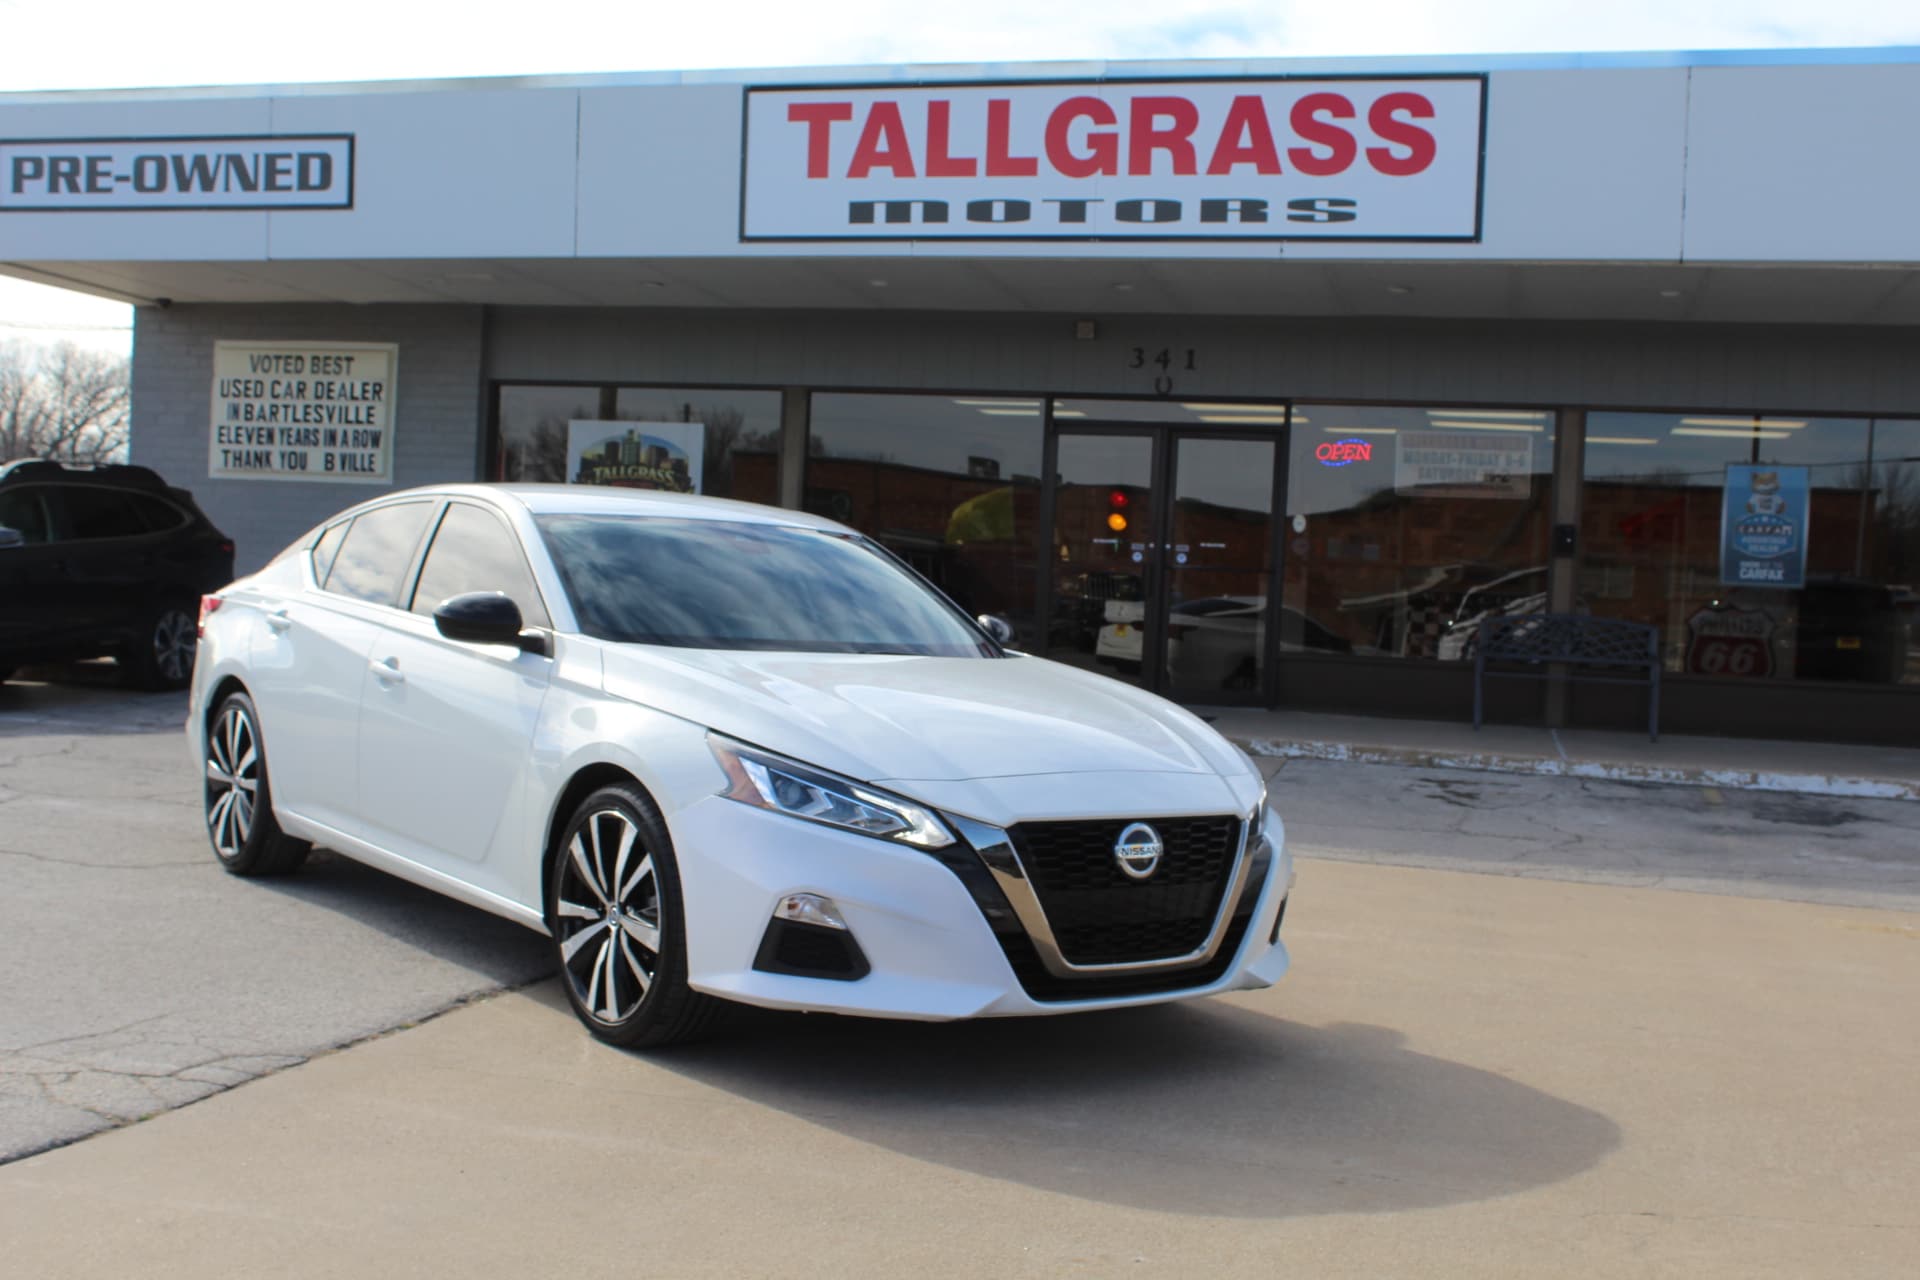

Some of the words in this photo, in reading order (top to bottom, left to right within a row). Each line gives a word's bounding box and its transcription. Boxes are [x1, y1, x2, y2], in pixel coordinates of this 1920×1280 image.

[788, 91, 1437, 179] TALLGRASS
[11, 152, 332, 193] PRE-OWNED
[847, 197, 1358, 224] MOTORS
[250, 354, 304, 374] VOTED
[310, 355, 355, 375] BEST
[1127, 347, 1198, 371] 341
[220, 379, 264, 399] USED
[270, 380, 307, 400] CAR
[314, 381, 383, 401] DEALER
[226, 402, 240, 421] IN
[244, 403, 376, 425] BARTLESVILLE
[217, 426, 275, 446] ELEVEN
[279, 427, 319, 447] YEARS
[323, 429, 337, 448] IN
[340, 430, 350, 448] A
[352, 429, 382, 449] ROW
[221, 449, 272, 469] THANK
[279, 451, 308, 471] YOU
[324, 452, 335, 472] B
[340, 453, 376, 473] VILLE
[1315, 442, 1373, 461] OPEN
[592, 465, 675, 484] TALLGRASS
[1739, 568, 1784, 580] CARFAX
[1700, 641, 1759, 673] 66
[1120, 846, 1161, 857] NISSAN
